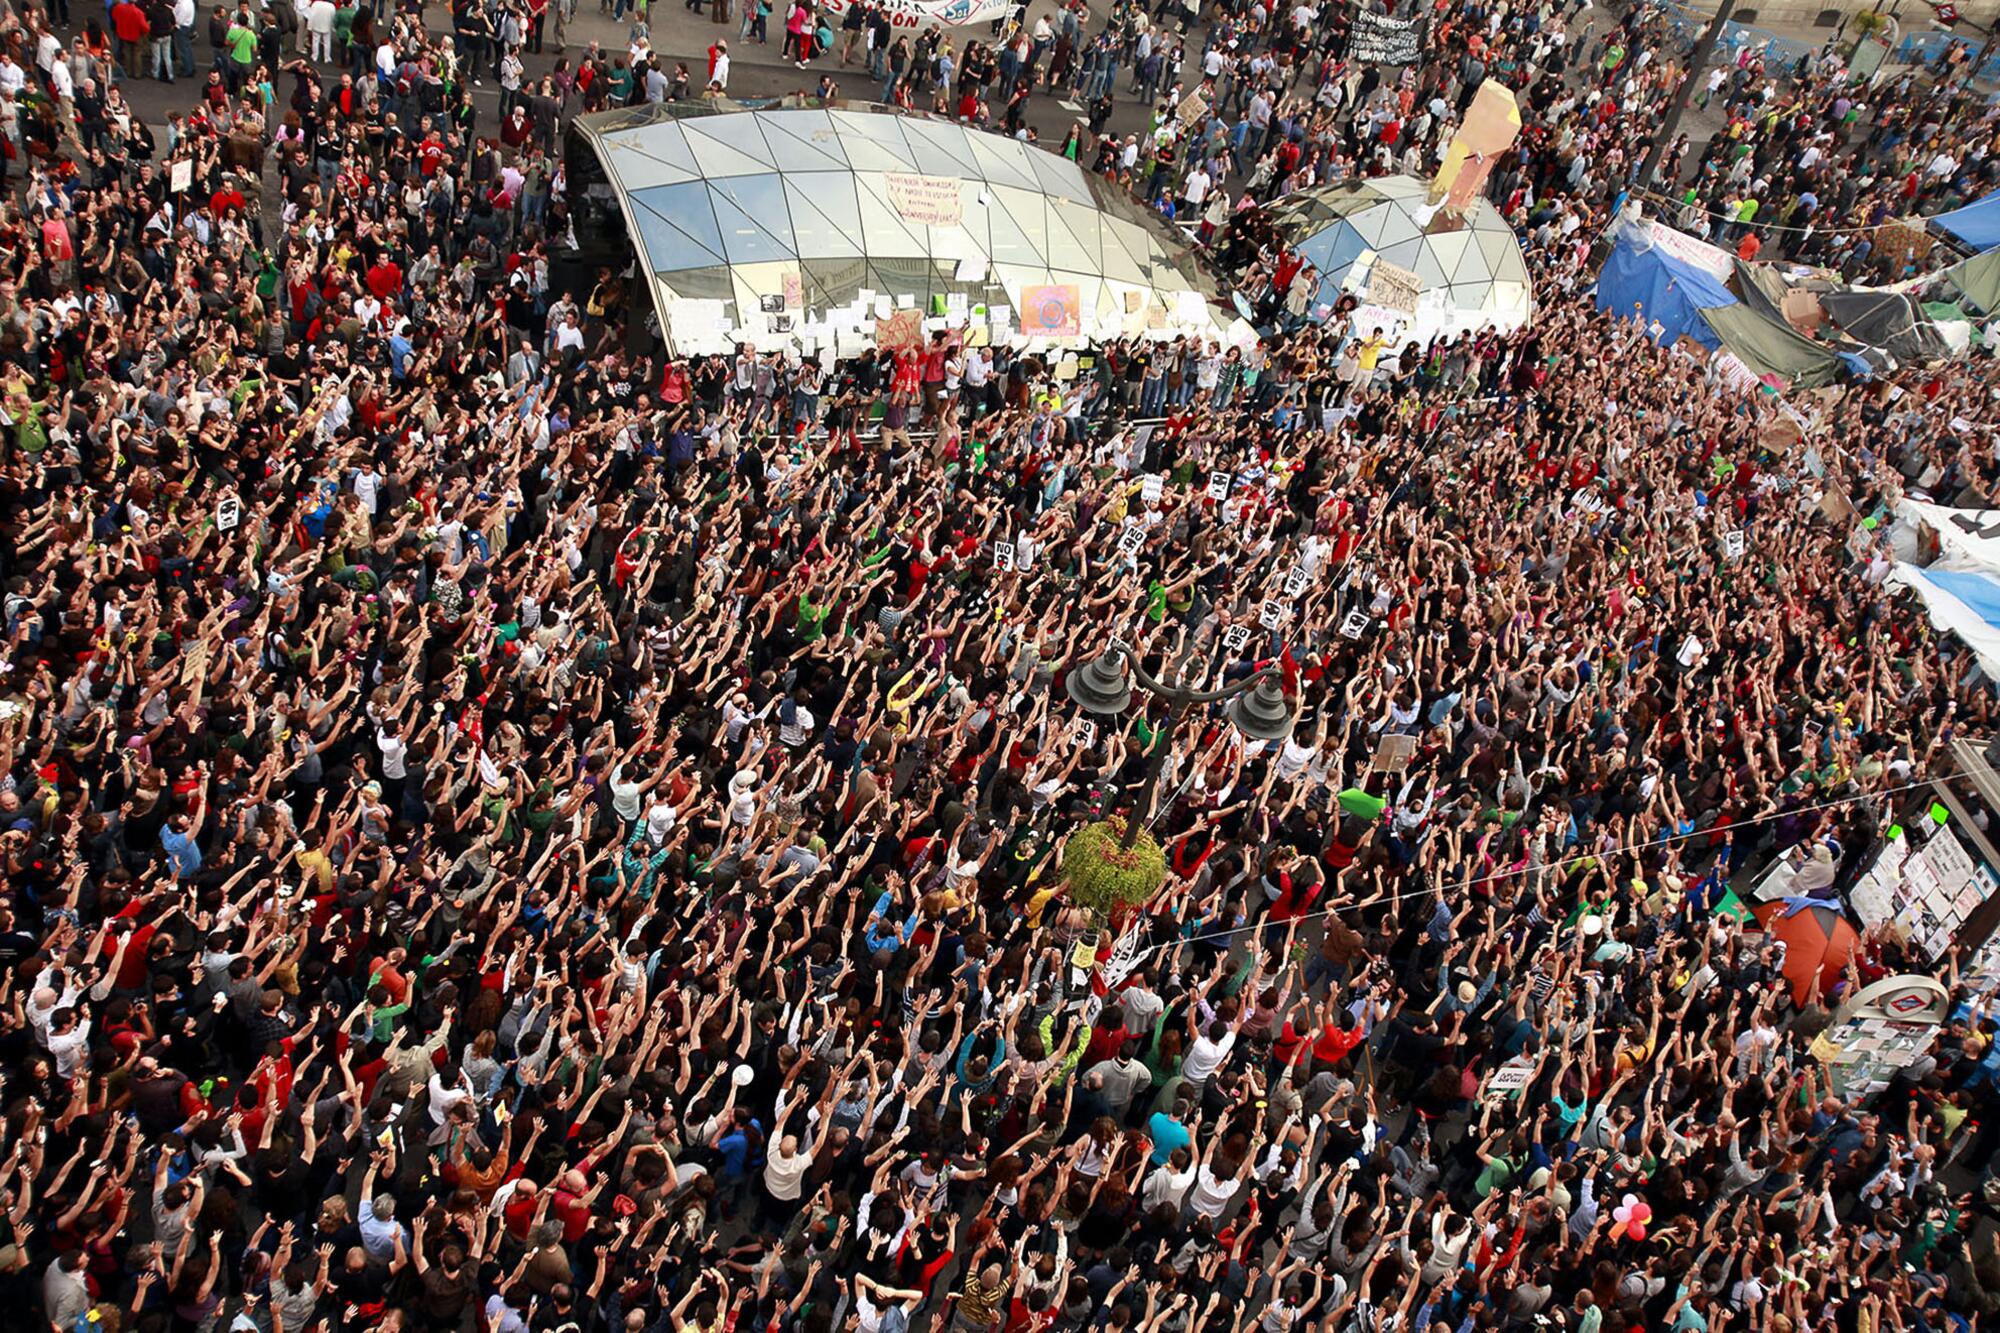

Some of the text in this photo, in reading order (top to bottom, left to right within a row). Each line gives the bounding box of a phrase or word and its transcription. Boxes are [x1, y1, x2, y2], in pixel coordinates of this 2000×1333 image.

[1127, 527, 1144, 541] NO
[996, 542, 1011, 555] NO
[1291, 567, 1305, 582] NO
[1230, 626, 1247, 638] NO
